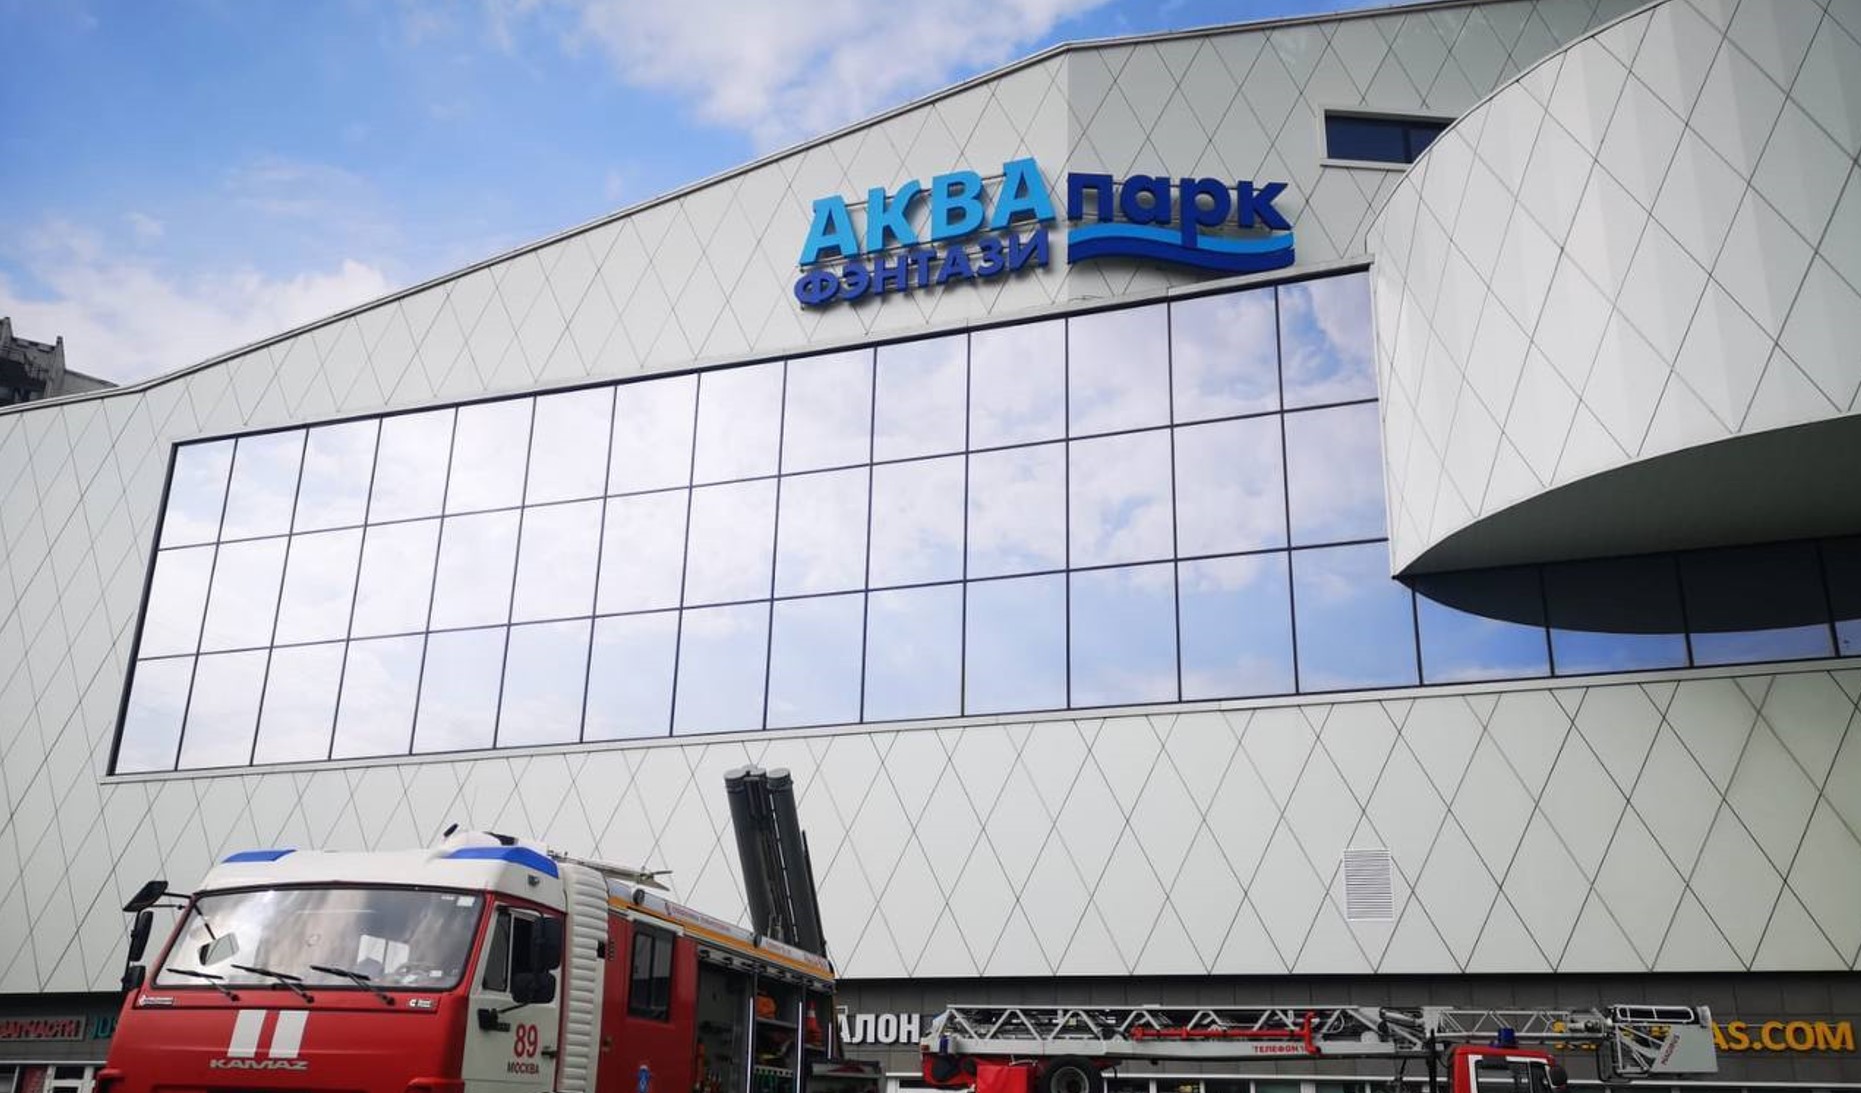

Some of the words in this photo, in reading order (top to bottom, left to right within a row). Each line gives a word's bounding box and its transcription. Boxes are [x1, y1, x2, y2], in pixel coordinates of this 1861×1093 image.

[799, 157, 1056, 266] АКВА
[1068, 171, 1293, 248] парк
[793, 229, 1050, 308] ФЭНТАЗИ
[514, 1023, 539, 1058] 89
[1254, 1045, 1299, 1054] ТЕЛЕФОН
[210, 1059, 308, 1070] KAMAZ
[507, 1061, 539, 1075] МОСКВА
